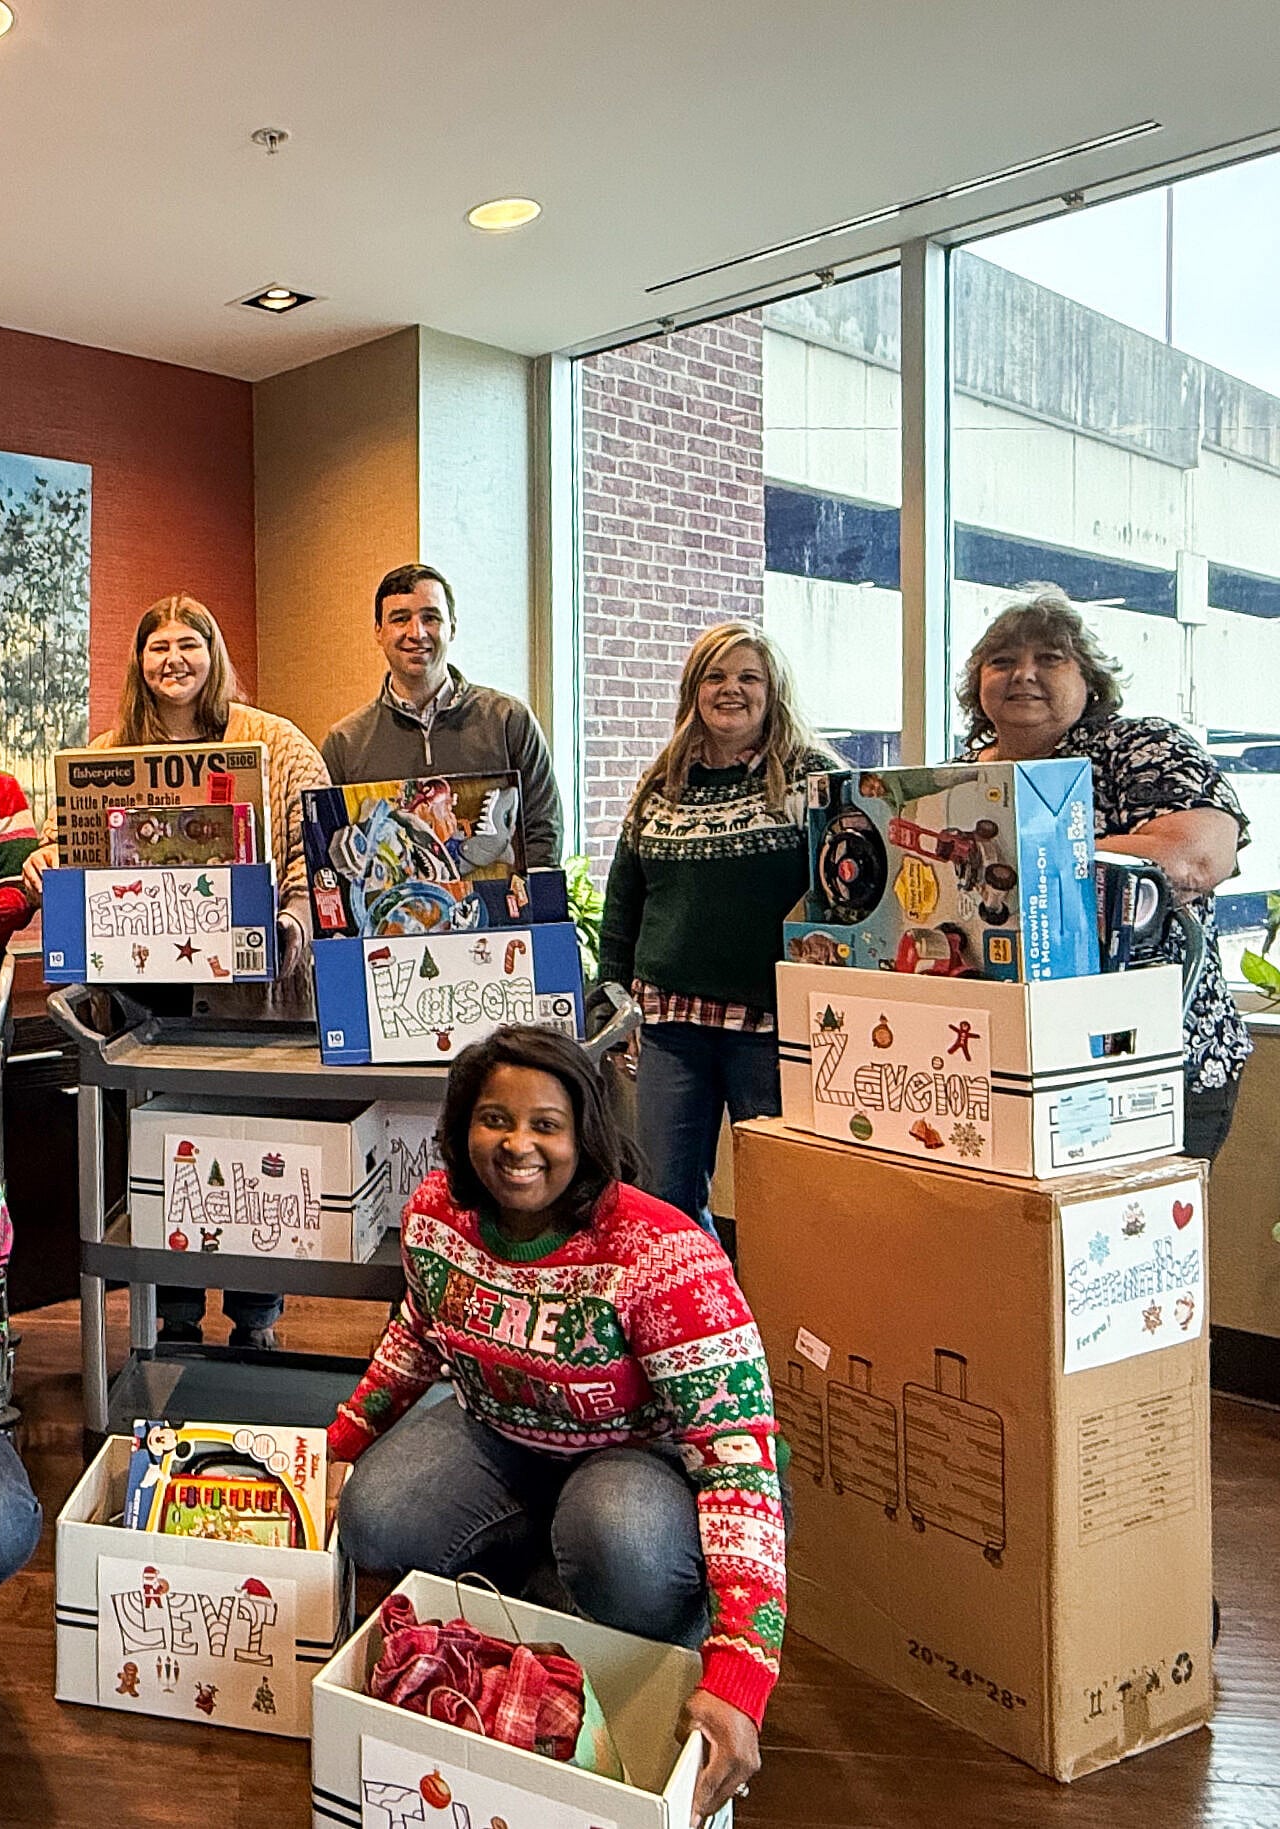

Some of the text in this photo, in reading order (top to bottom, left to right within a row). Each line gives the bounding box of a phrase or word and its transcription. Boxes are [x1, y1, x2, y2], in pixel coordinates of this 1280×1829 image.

[73, 766, 131, 780] fisher-price
[143, 753, 226, 789] TOYS
[70, 792, 181, 810] Little People Barbie
[71, 813, 102, 828] Beach
[73, 848, 102, 863] MADE
[1037, 847, 1049, 910] Ride-On
[89, 872, 229, 938] Emilia
[1029, 895, 1039, 959] Growing
[51, 954, 62, 963] 10
[1040, 913, 1050, 965] Mower
[372, 959, 535, 1040] Kason
[330, 1033, 342, 1043] 10
[813, 1033, 990, 1122] Zaveion
[168, 1162, 321, 1252] Aaliyah
[294, 1435, 308, 1492] MICKEY
[111, 1590, 277, 1667] LEVI
